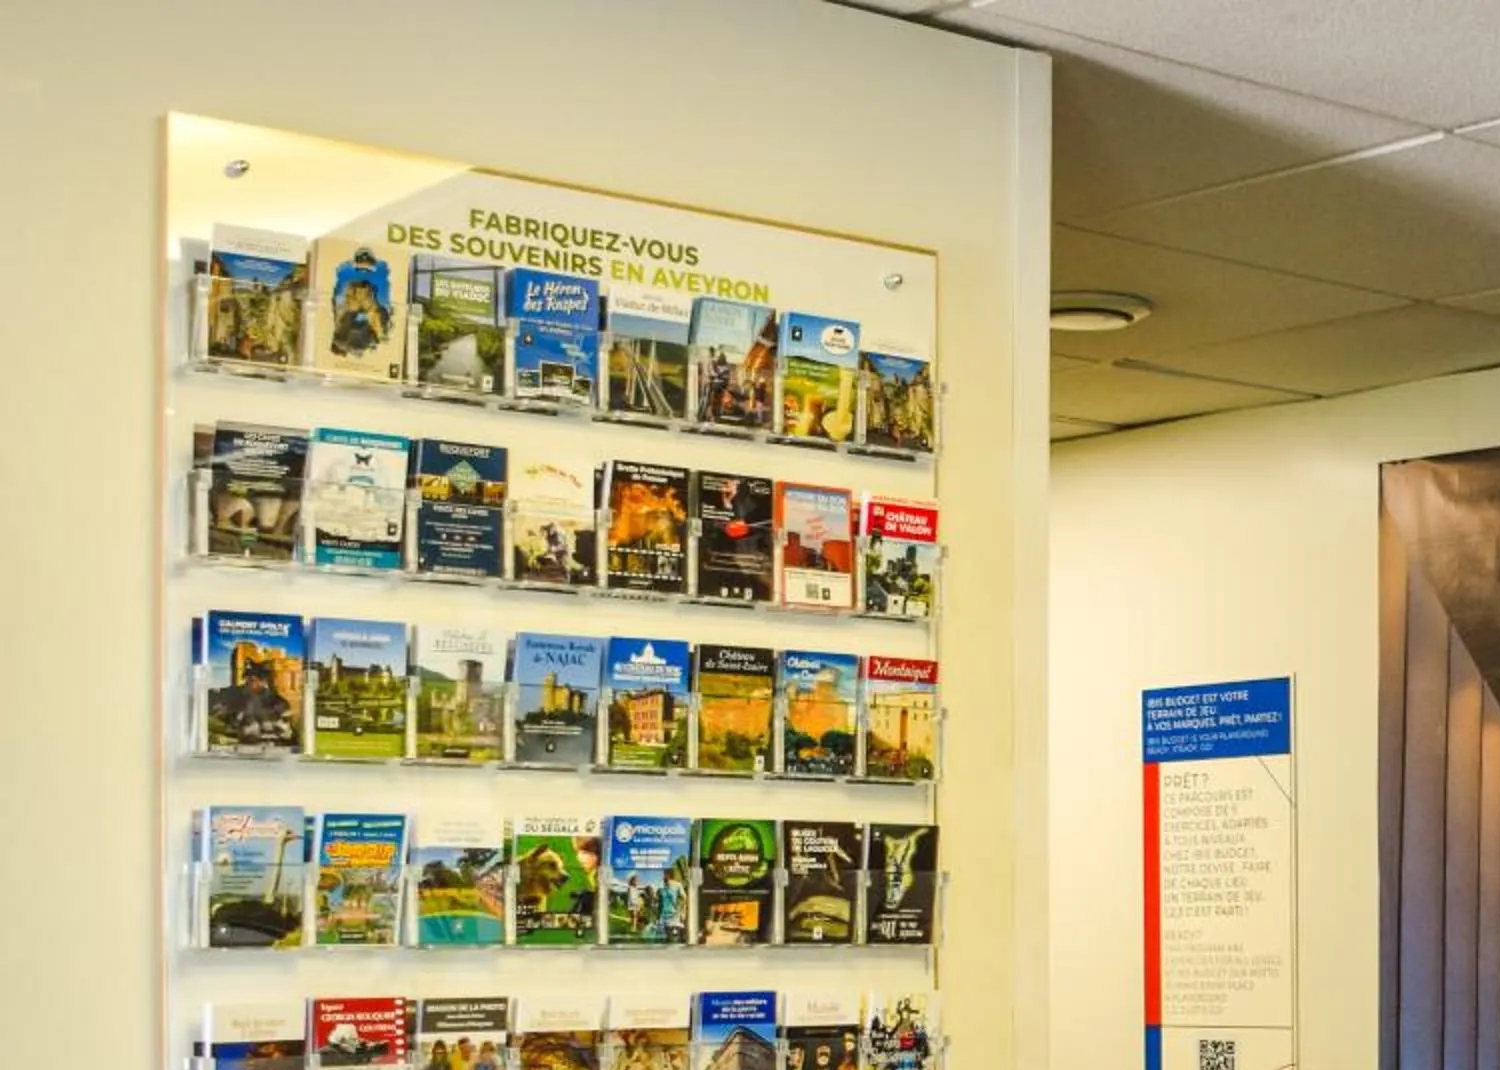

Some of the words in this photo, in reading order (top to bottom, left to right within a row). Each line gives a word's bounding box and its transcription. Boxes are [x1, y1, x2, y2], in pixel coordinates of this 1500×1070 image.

[469, 208, 700, 266] FABRIQUEZ-VOUS
[387, 223, 441, 251] DES
[450, 232, 602, 277] SOUVENIRS
[610, 259, 646, 286] EN
[653, 270, 770, 303] AVEYRON
[545, 652, 587, 667] NAJAC
[1165, 695, 1201, 706] BUDGET
[1202, 693, 1217, 704] EST
[1220, 690, 1249, 702] VOTRE
[1148, 708, 1184, 720] TERRAIN
[1185, 707, 1197, 717] DE
[1199, 706, 1217, 716] JEU
[1235, 788, 1253, 801] EST
